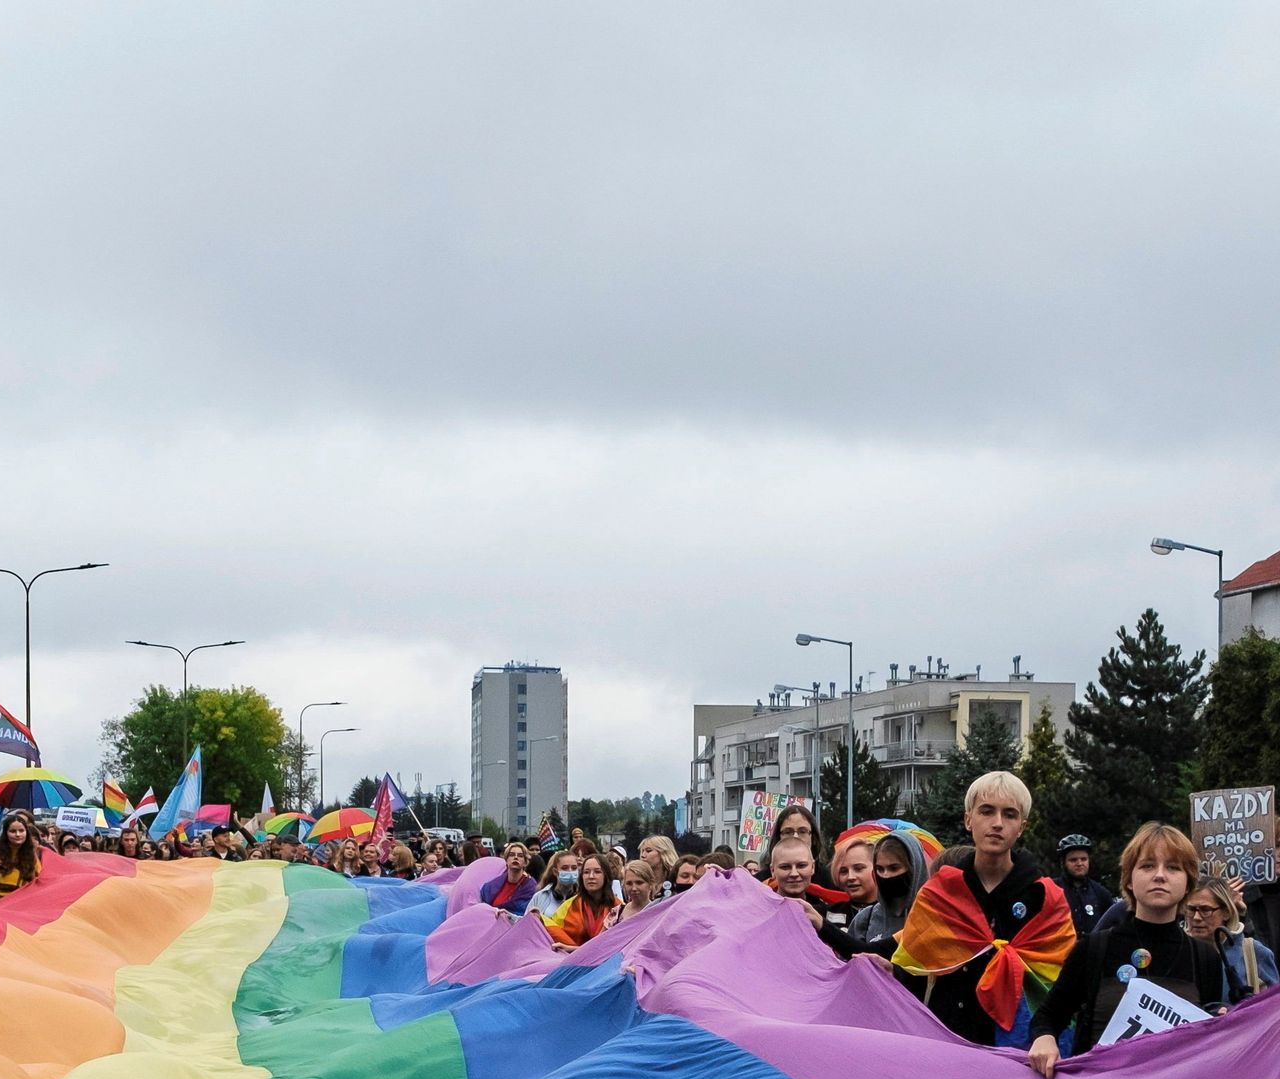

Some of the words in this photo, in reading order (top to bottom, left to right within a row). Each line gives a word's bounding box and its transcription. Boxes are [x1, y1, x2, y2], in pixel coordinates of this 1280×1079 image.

[1194, 790, 1272, 822] KAŻDY
[1225, 820, 1244, 832] MA
[1203, 830, 1264, 848] PRAWO
[1224, 844, 1244, 856] DO
